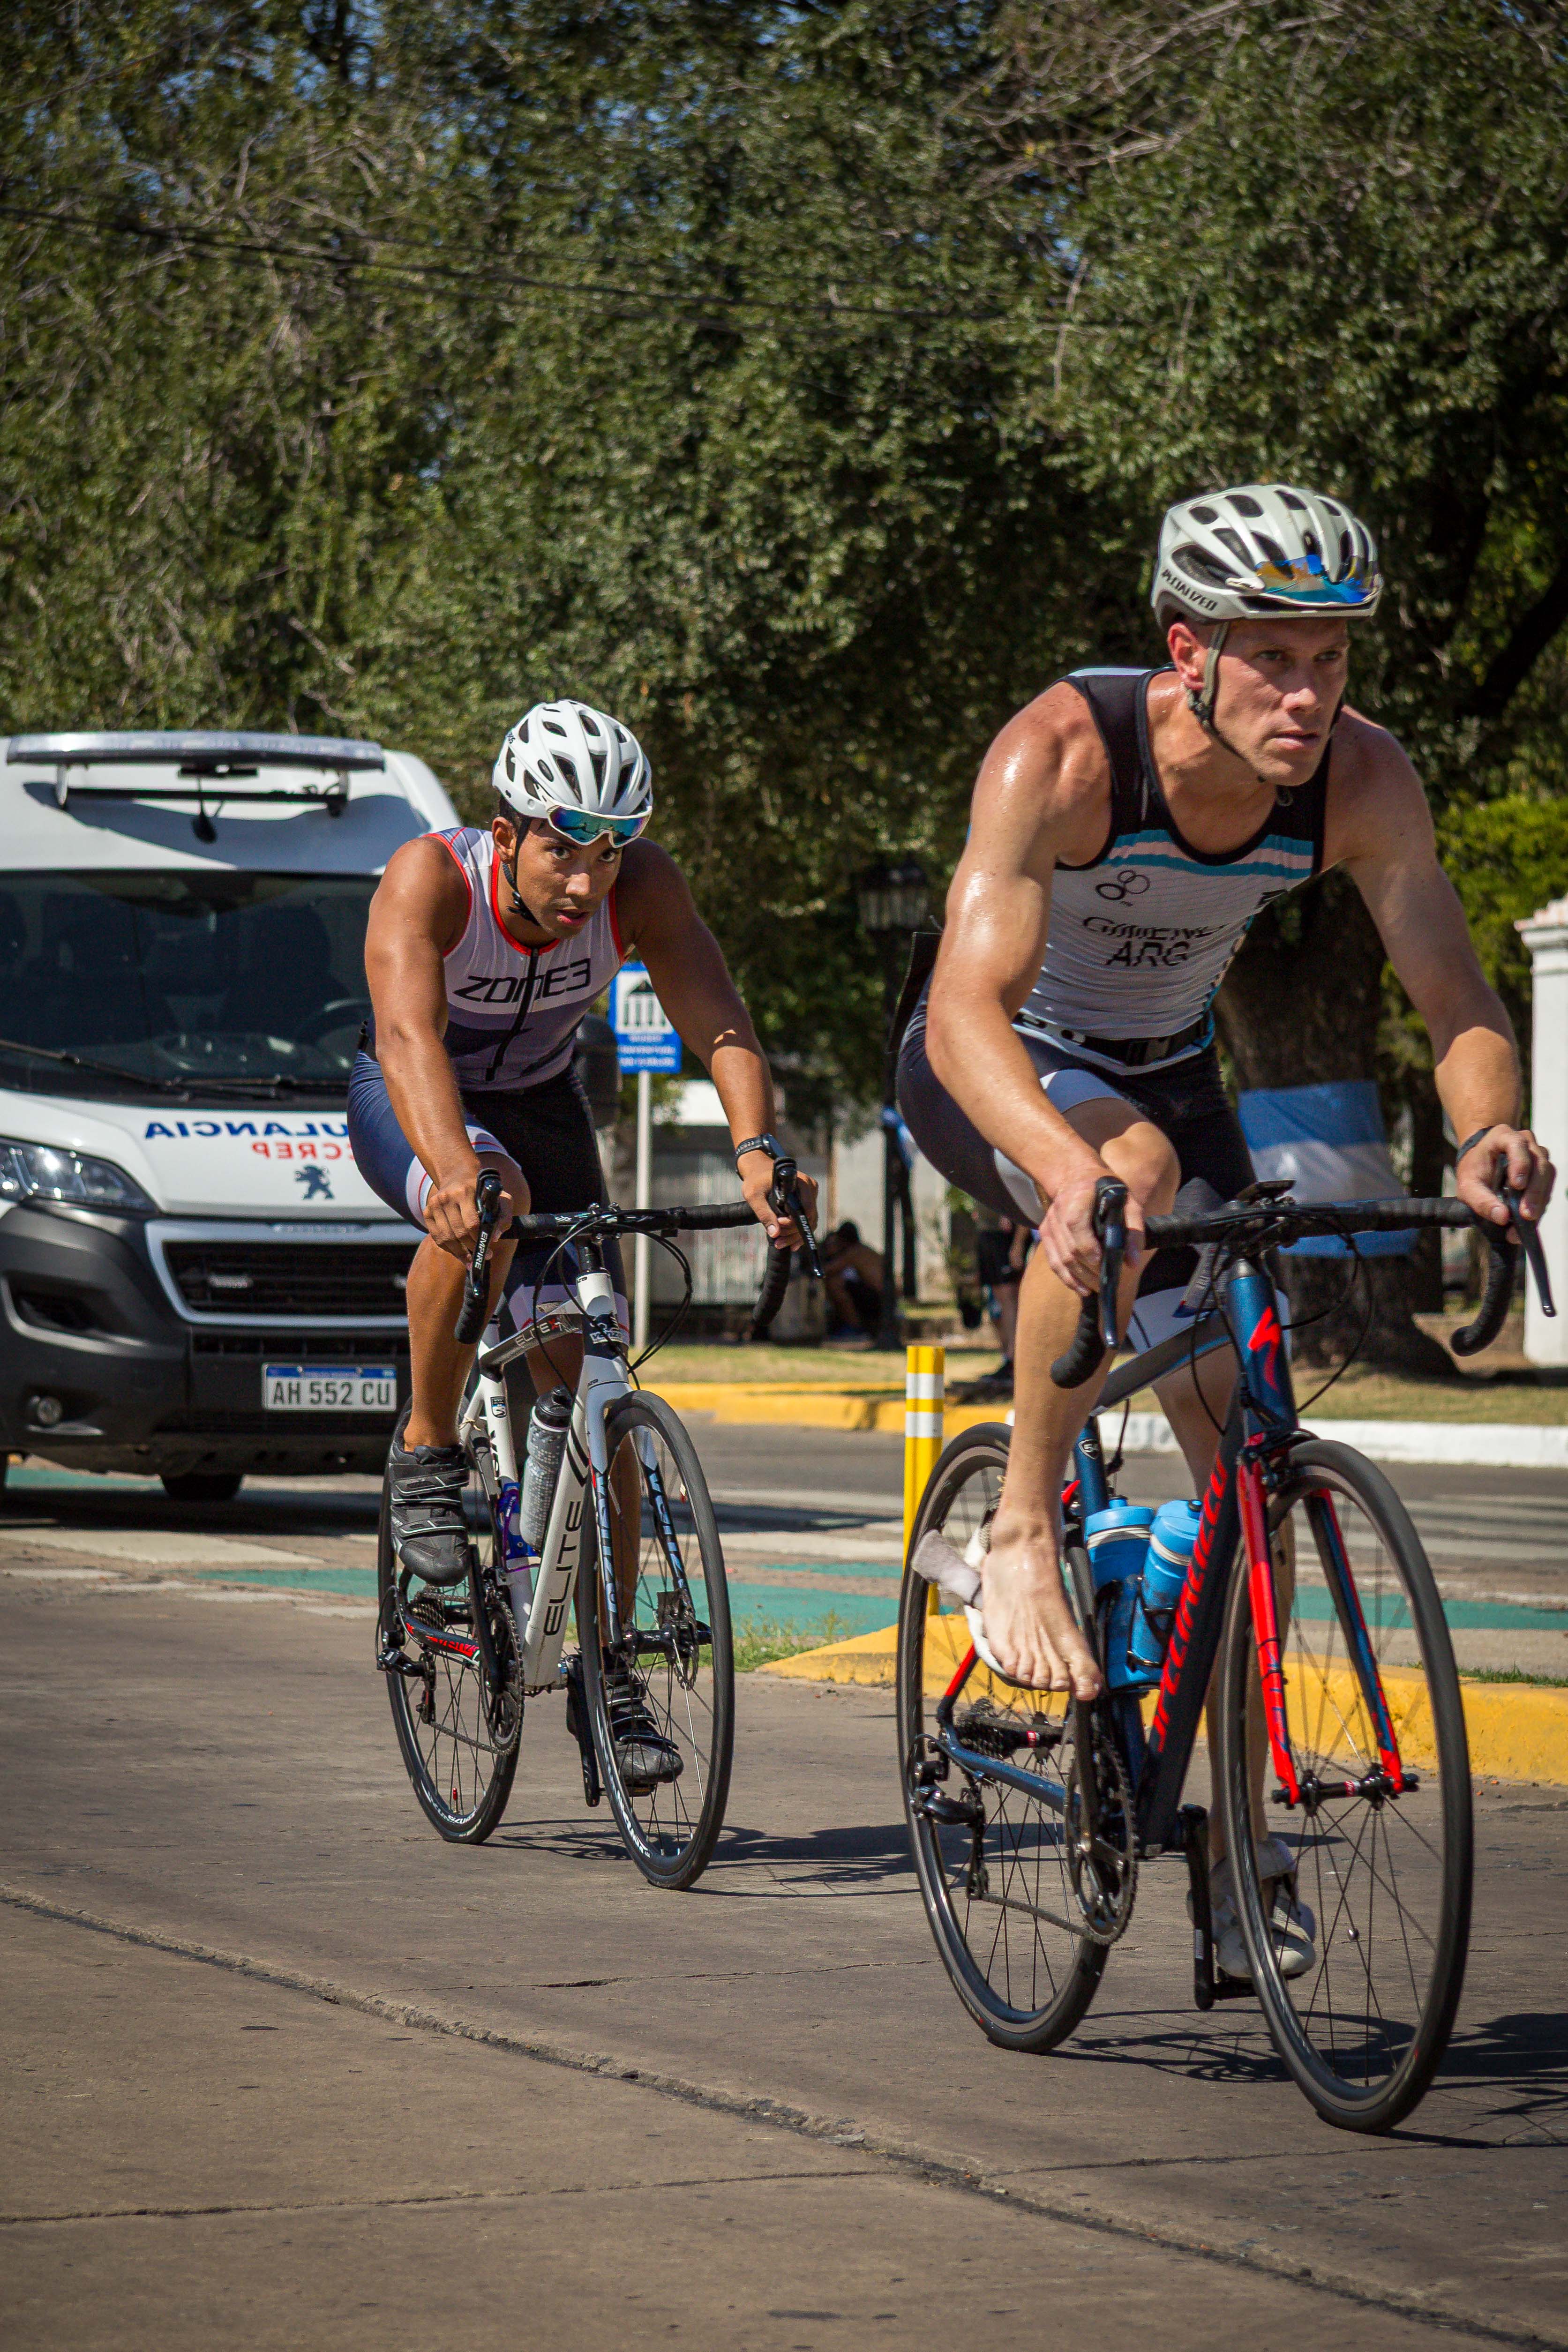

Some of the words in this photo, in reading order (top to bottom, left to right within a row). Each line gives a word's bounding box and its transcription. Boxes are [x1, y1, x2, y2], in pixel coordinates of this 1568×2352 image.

[1105, 940, 1190, 967] ARG
[474, 1231, 488, 1270] EMPIRE
[273, 1381, 300, 1405] AH
[310, 1382, 353, 1405] 552
[362, 1382, 390, 1406] CU
